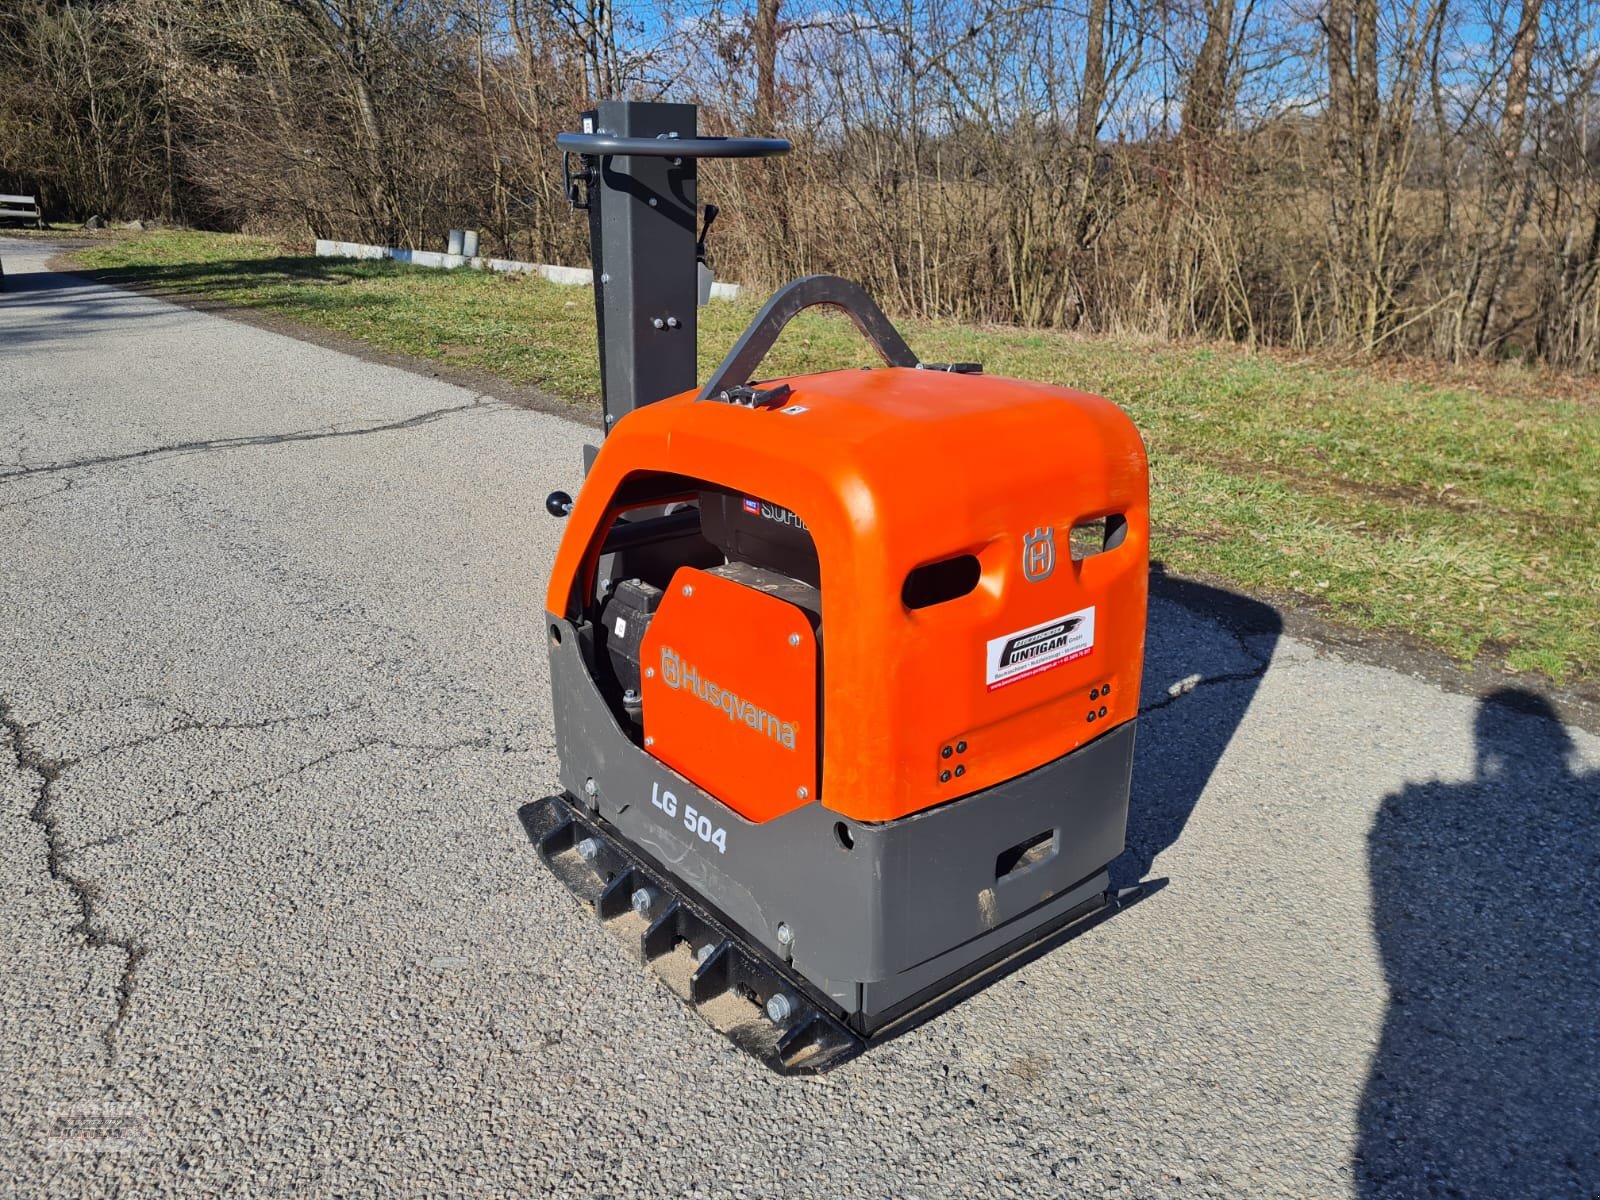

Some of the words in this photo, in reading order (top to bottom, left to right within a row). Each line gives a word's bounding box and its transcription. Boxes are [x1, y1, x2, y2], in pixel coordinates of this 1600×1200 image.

[681, 661, 796, 750] Husqvarna
[652, 782, 678, 818] LG
[683, 805, 727, 855] 504
